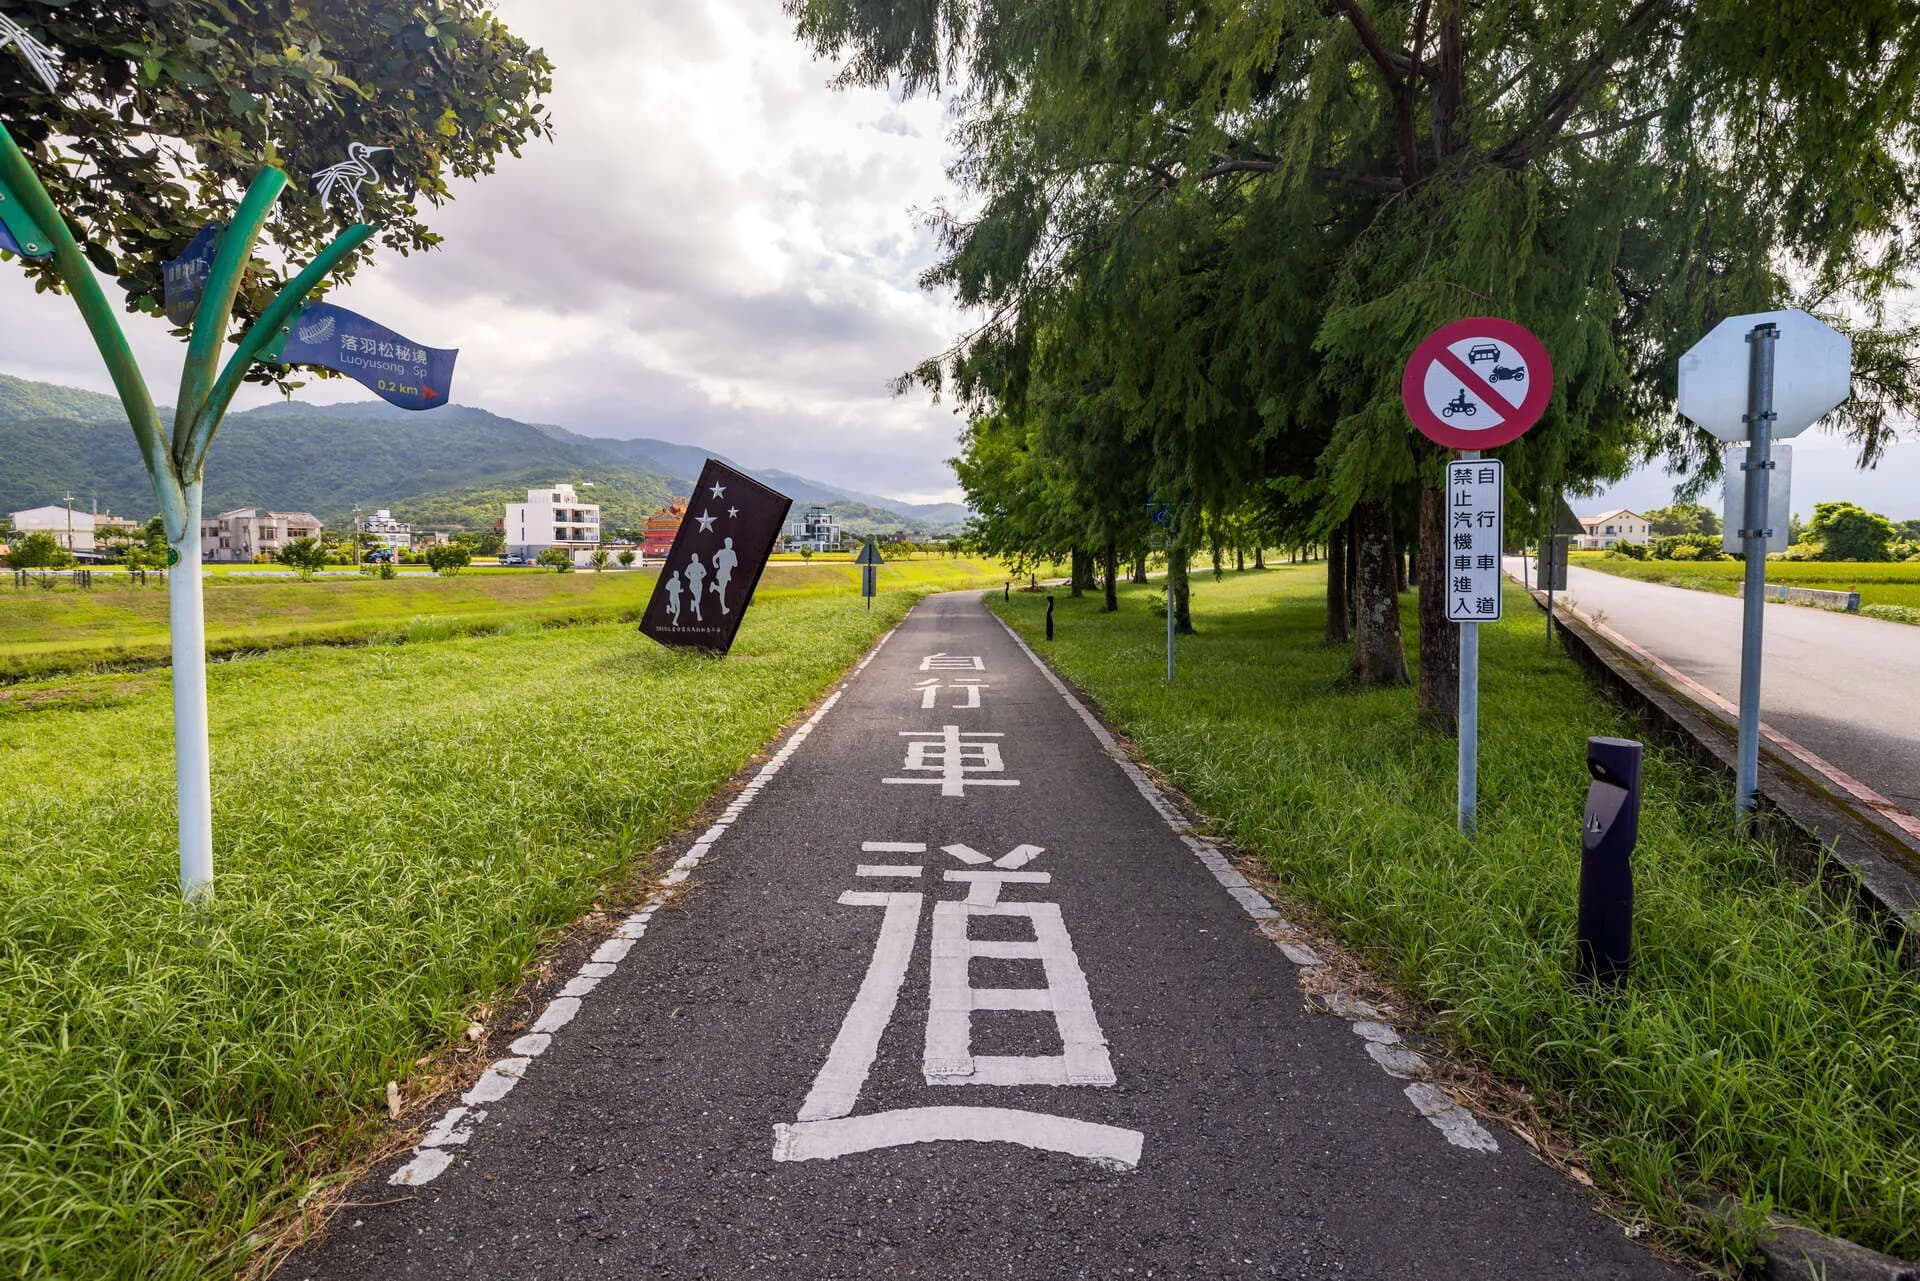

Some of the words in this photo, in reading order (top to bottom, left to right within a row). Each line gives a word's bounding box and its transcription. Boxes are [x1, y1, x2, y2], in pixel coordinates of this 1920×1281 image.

[340, 352, 405, 376] Luoyusong
[378, 379, 396, 392] 0.2
[400, 383, 418, 396] km
[1453, 468, 1473, 614] 禁止汽機車進入
[1476, 467, 1495, 614] 自行車道
[773, 653, 1144, 1171] 自行車道
